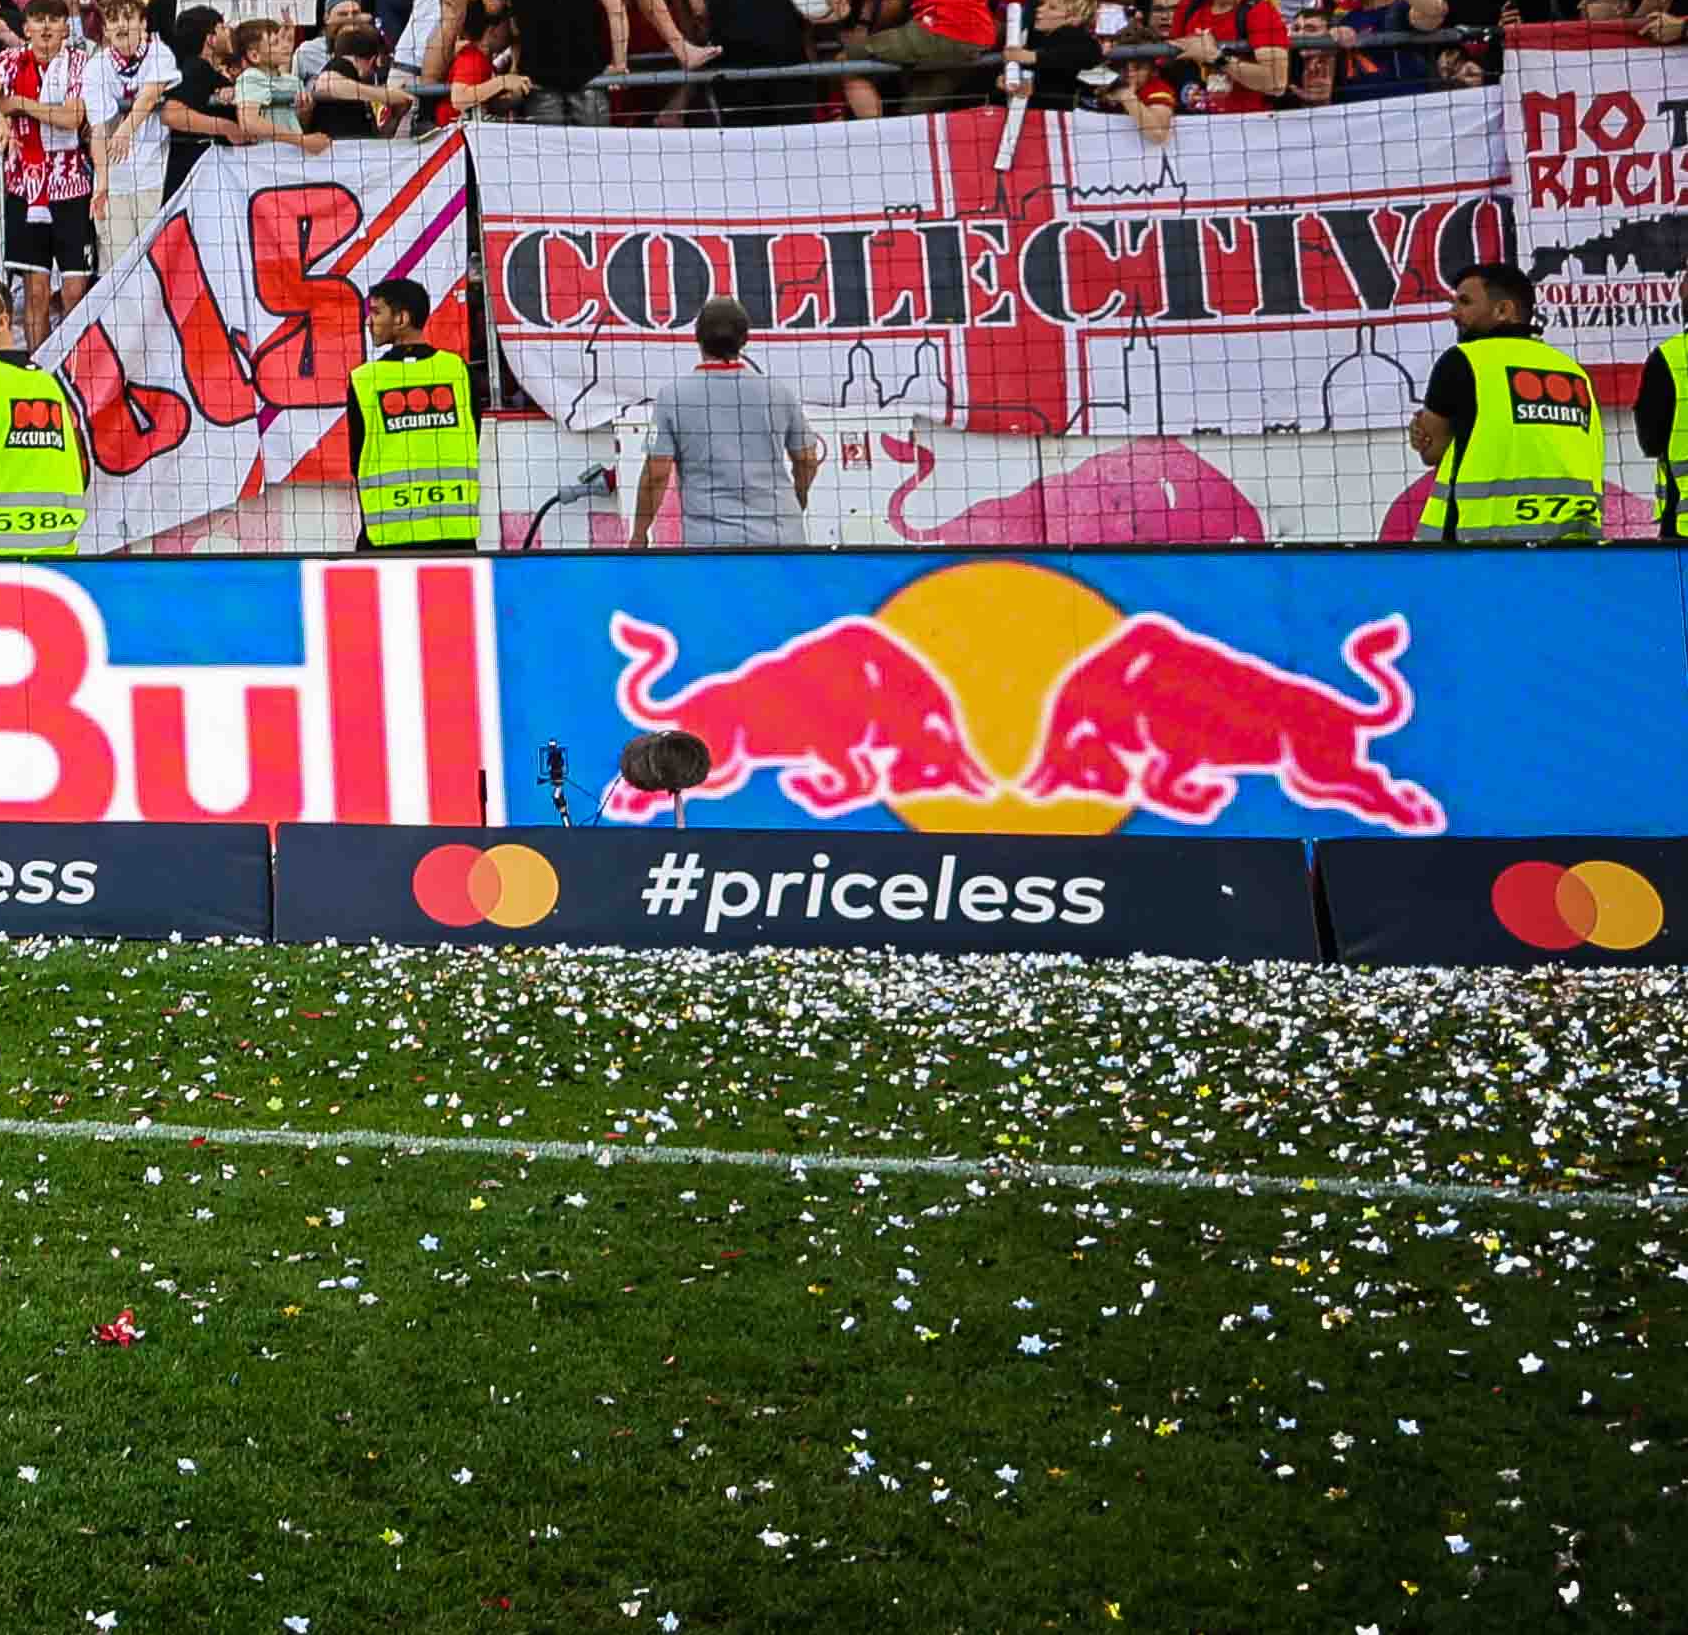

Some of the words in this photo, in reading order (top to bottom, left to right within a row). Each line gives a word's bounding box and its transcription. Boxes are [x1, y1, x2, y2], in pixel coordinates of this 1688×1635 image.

[1522, 90, 1647, 153] NO
[502, 194, 1519, 327] COLLECTIVO
[1535, 282, 1685, 306] COLLECTIV
[385, 408, 457, 432] SECURITAS
[392, 483, 467, 509] 5761
[641, 852, 1106, 932] #priceless
